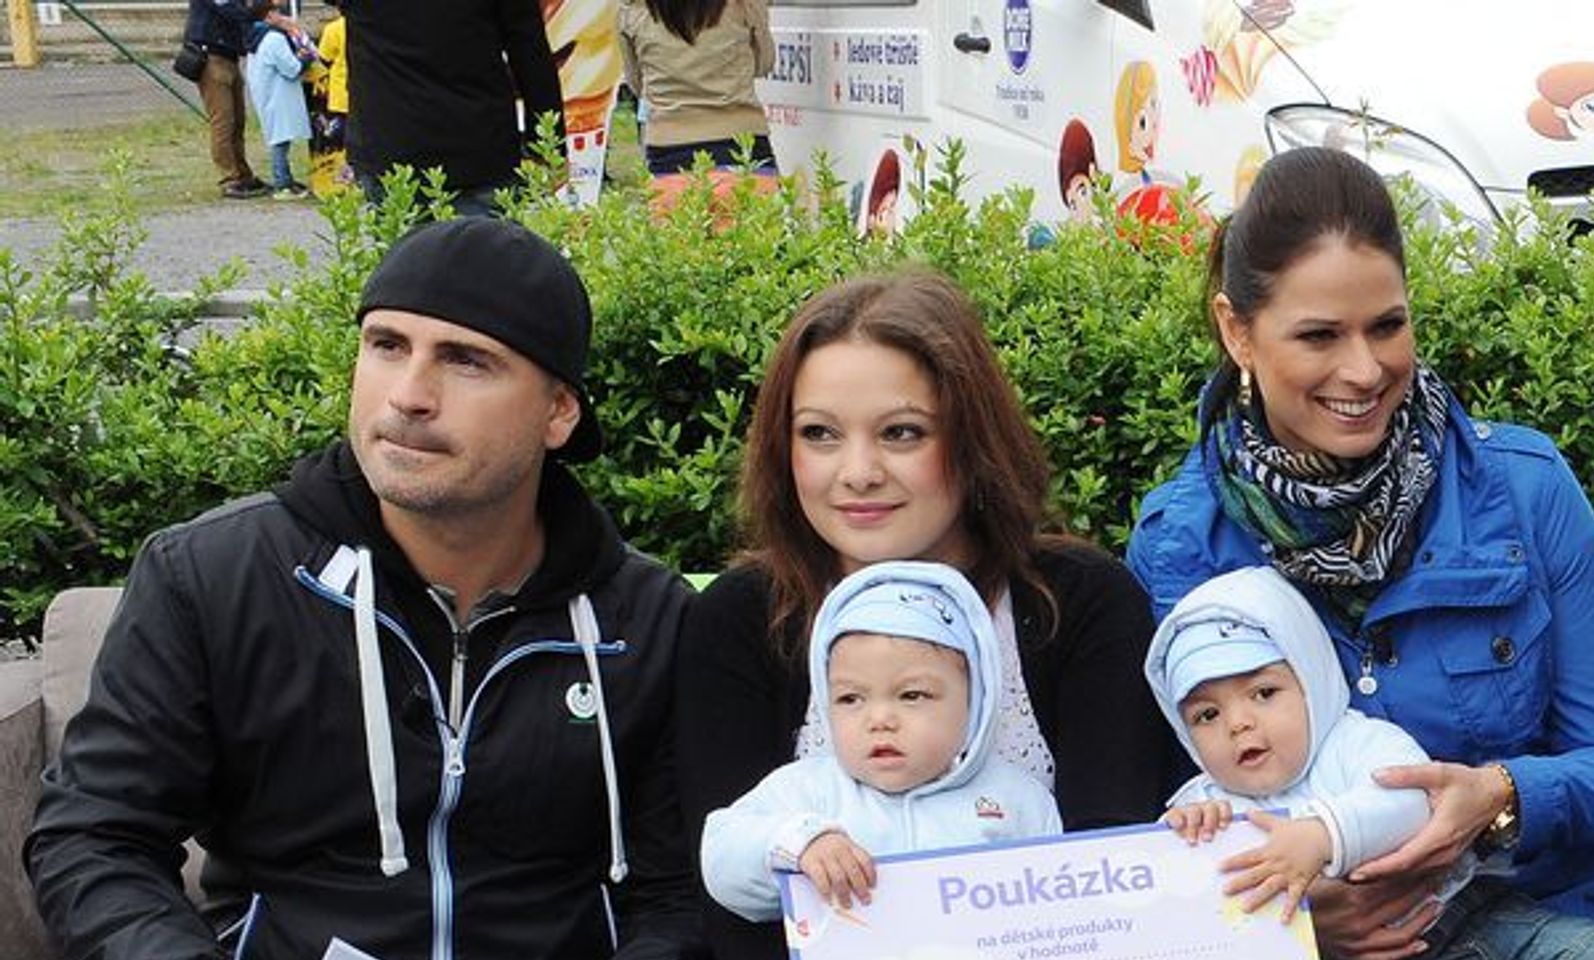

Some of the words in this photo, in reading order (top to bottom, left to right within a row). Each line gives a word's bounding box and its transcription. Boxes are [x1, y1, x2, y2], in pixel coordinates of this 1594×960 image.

[938, 858, 1155, 915] Poukázka
[977, 935, 998, 950] na
[1001, 926, 1055, 947] dětské
[1058, 916, 1134, 941] produkty
[1017, 949, 1029, 960] v
[1030, 938, 1099, 959] hodnotě
